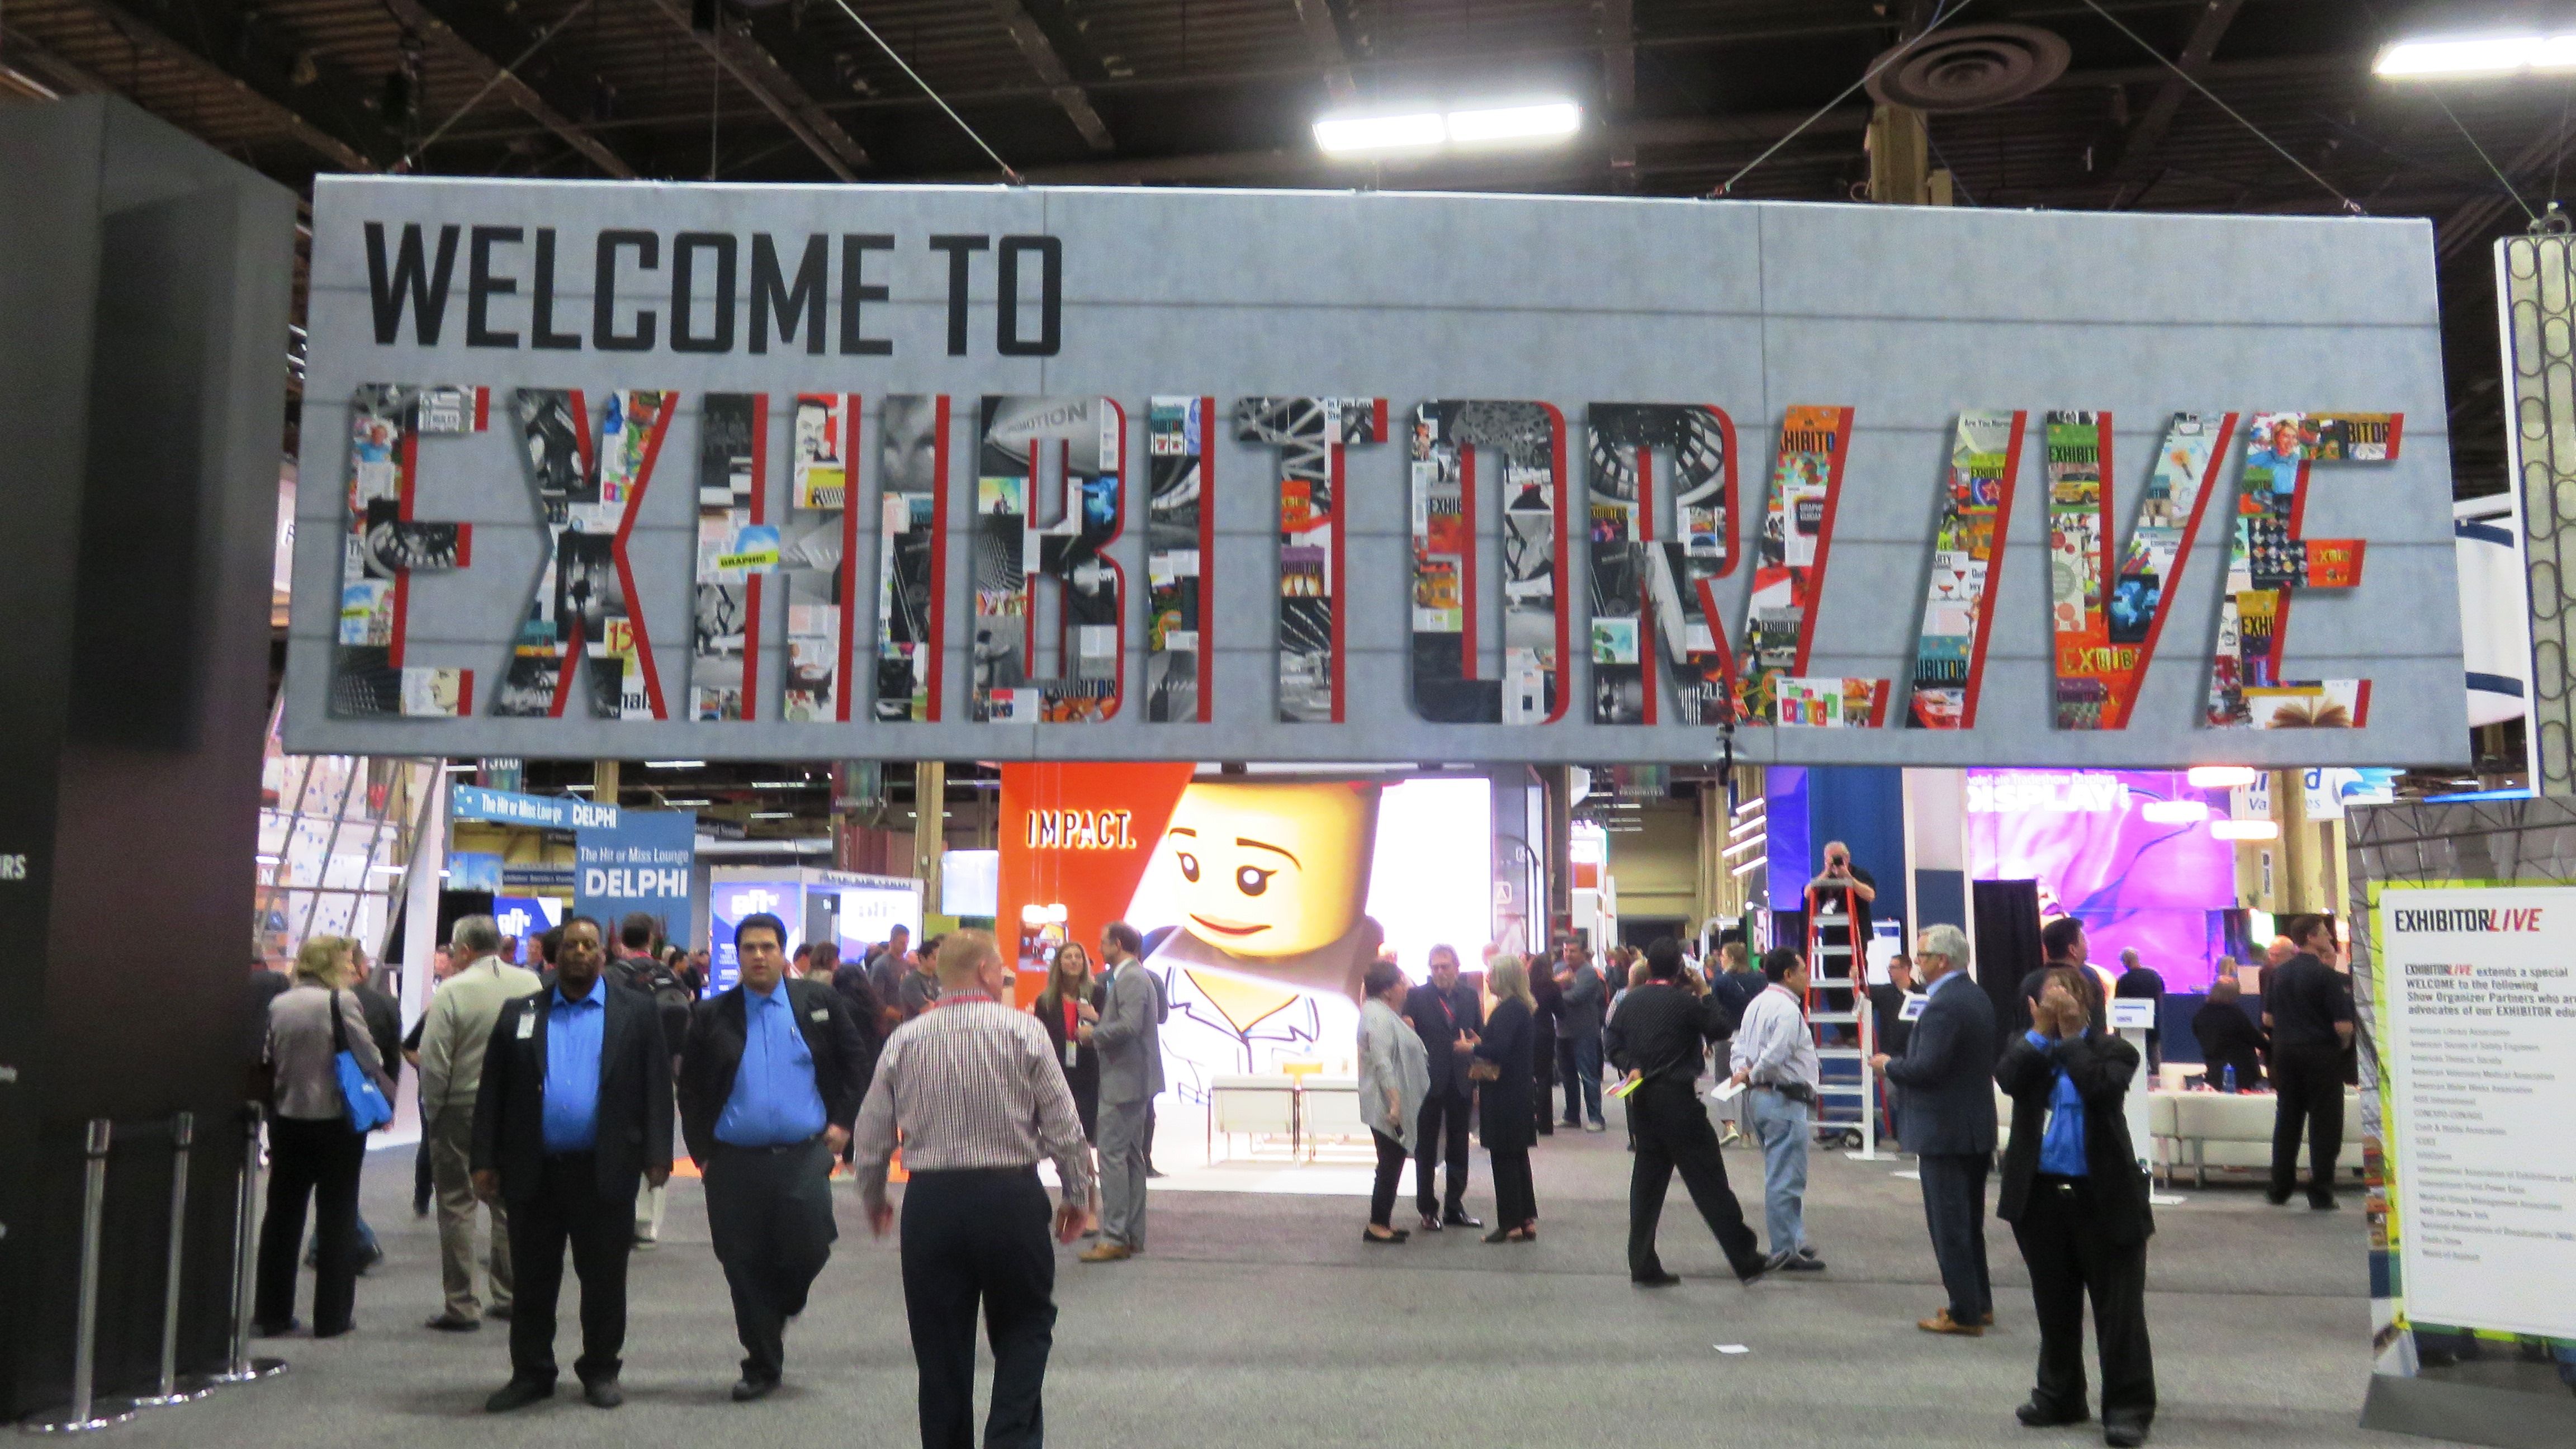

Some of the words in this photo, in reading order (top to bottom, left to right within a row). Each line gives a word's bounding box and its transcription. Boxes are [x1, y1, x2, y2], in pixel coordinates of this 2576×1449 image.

[364, 221, 894, 355] WELCOME
[929, 234, 1062, 356] TO
[481, 793, 496, 813] The
[497, 795, 509, 816] Hit
[509, 802, 517, 817] or
[519, 799, 536, 818] Miss
[572, 803, 617, 828] DELPHI
[580, 845, 598, 863] The
[600, 846, 614, 863] Hit
[616, 850, 626, 863] or
[628, 846, 651, 863] Miss
[654, 846, 689, 866] Lounge
[585, 868, 688, 898] DELPHI
[2476, 967, 2517, 977] extends
[2530, 967, 2568, 978] special
[2405, 979, 2455, 989] WELCOME
[2472, 979, 2488, 990] the
[2491, 979, 2539, 992] following
[2407, 991, 2432, 1002] Show
[2436, 992, 2486, 1005] Organizer
[2489, 992, 2535, 1004] Partners
[2408, 1005, 2459, 1016] advocates
[2496, 1005, 2552, 1017] EXHIBITOR
